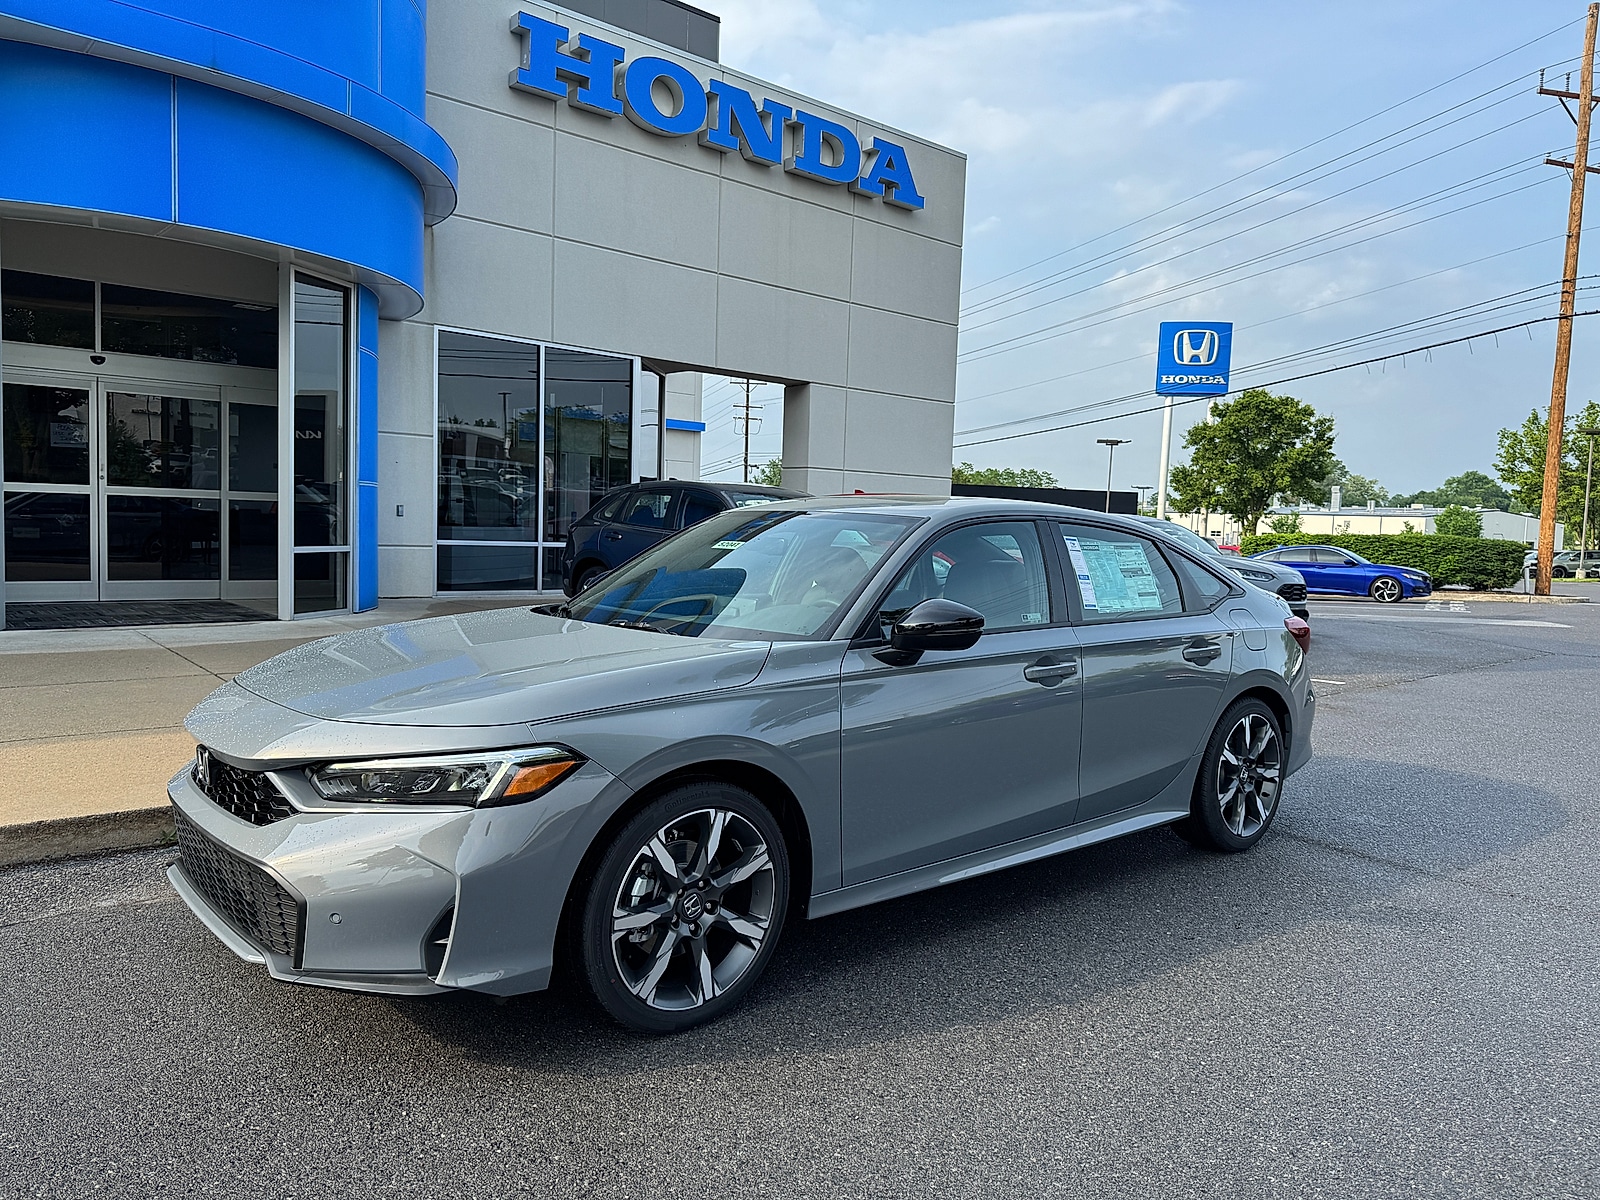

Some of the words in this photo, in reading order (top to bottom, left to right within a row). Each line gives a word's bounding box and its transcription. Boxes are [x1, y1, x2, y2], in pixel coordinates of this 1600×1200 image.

[511, 11, 925, 211] HONDA
[1161, 375, 1226, 384] HONDA
[664, 791, 704, 813] Continental
